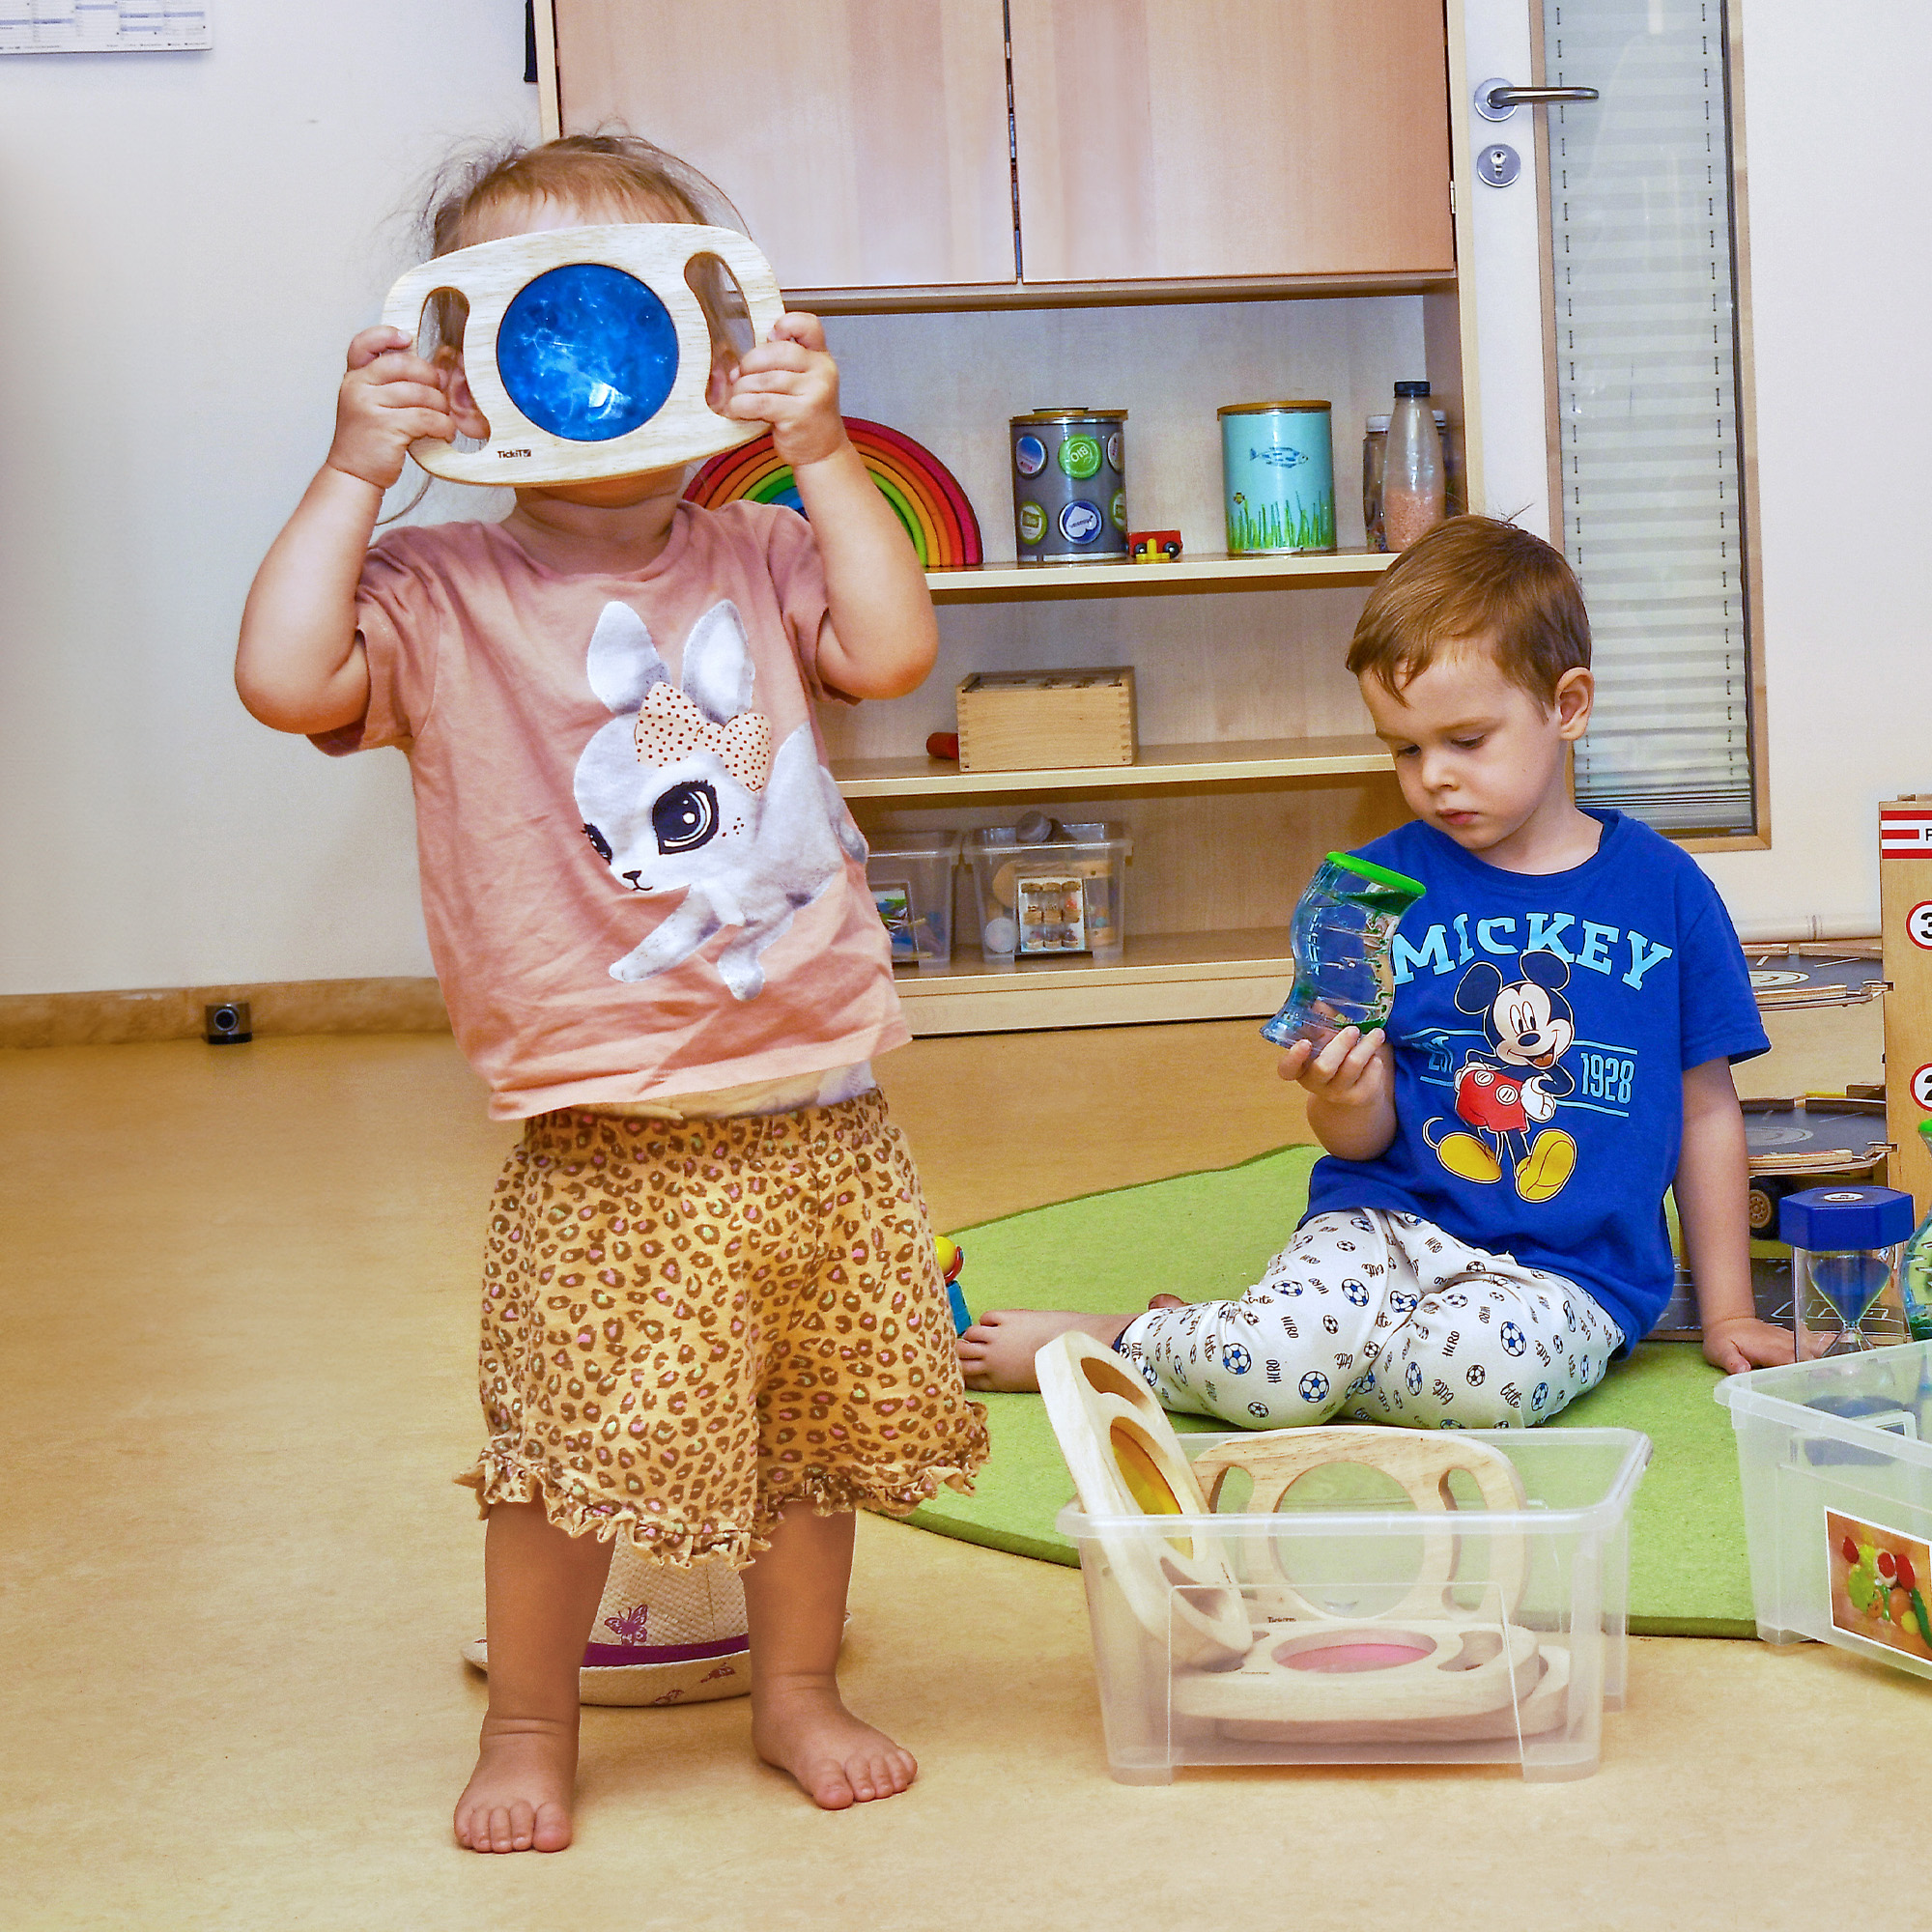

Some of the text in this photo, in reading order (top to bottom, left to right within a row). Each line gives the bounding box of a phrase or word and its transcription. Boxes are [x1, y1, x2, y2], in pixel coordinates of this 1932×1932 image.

[1069, 445, 1089, 463] BIO
[1391, 913, 1673, 991] MICKEY
[1579, 1052, 1634, 1104] 1928
[1265, 1359, 1282, 1384] HERO
